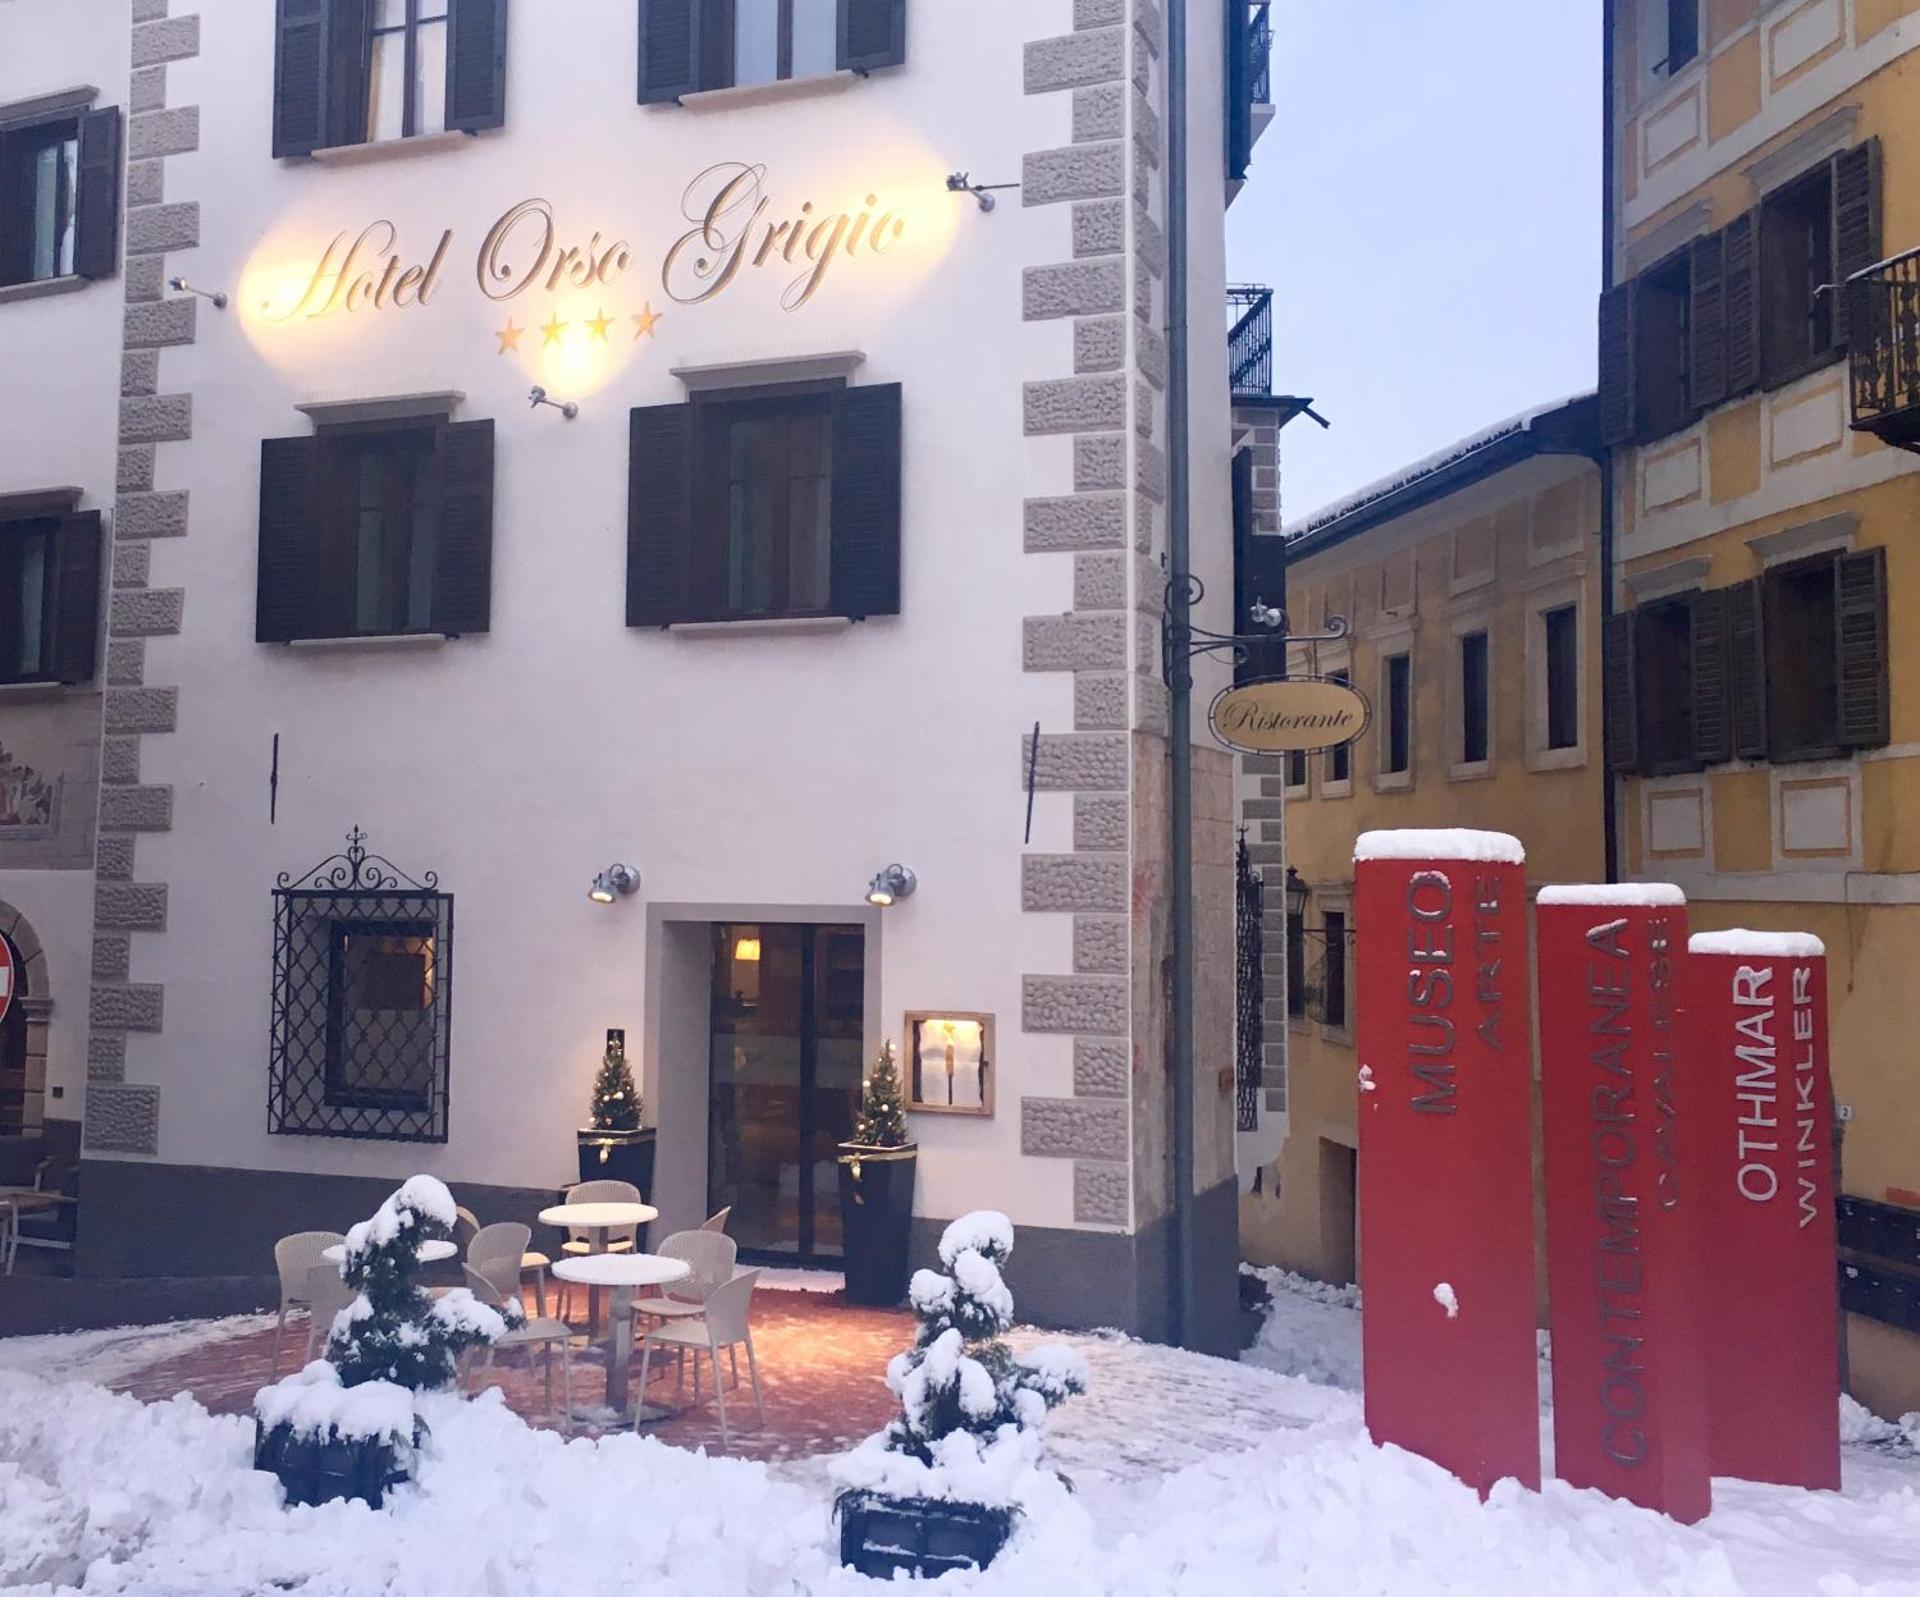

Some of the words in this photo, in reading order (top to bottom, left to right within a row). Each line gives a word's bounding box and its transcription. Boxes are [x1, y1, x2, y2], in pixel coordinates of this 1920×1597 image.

[262, 219, 453, 322] Hotel
[477, 197, 635, 301] Orso
[662, 161, 905, 313] Grigio
[1223, 700, 1354, 731] Ristorante
[1407, 870, 1457, 1116] MUSEO
[1475, 874, 1504, 1052] ARTE
[1586, 918, 1647, 1468] CONTEMPORANEA
[1732, 965, 1778, 1202] OTHMAR
[1792, 967, 1818, 1229] WINKLER
